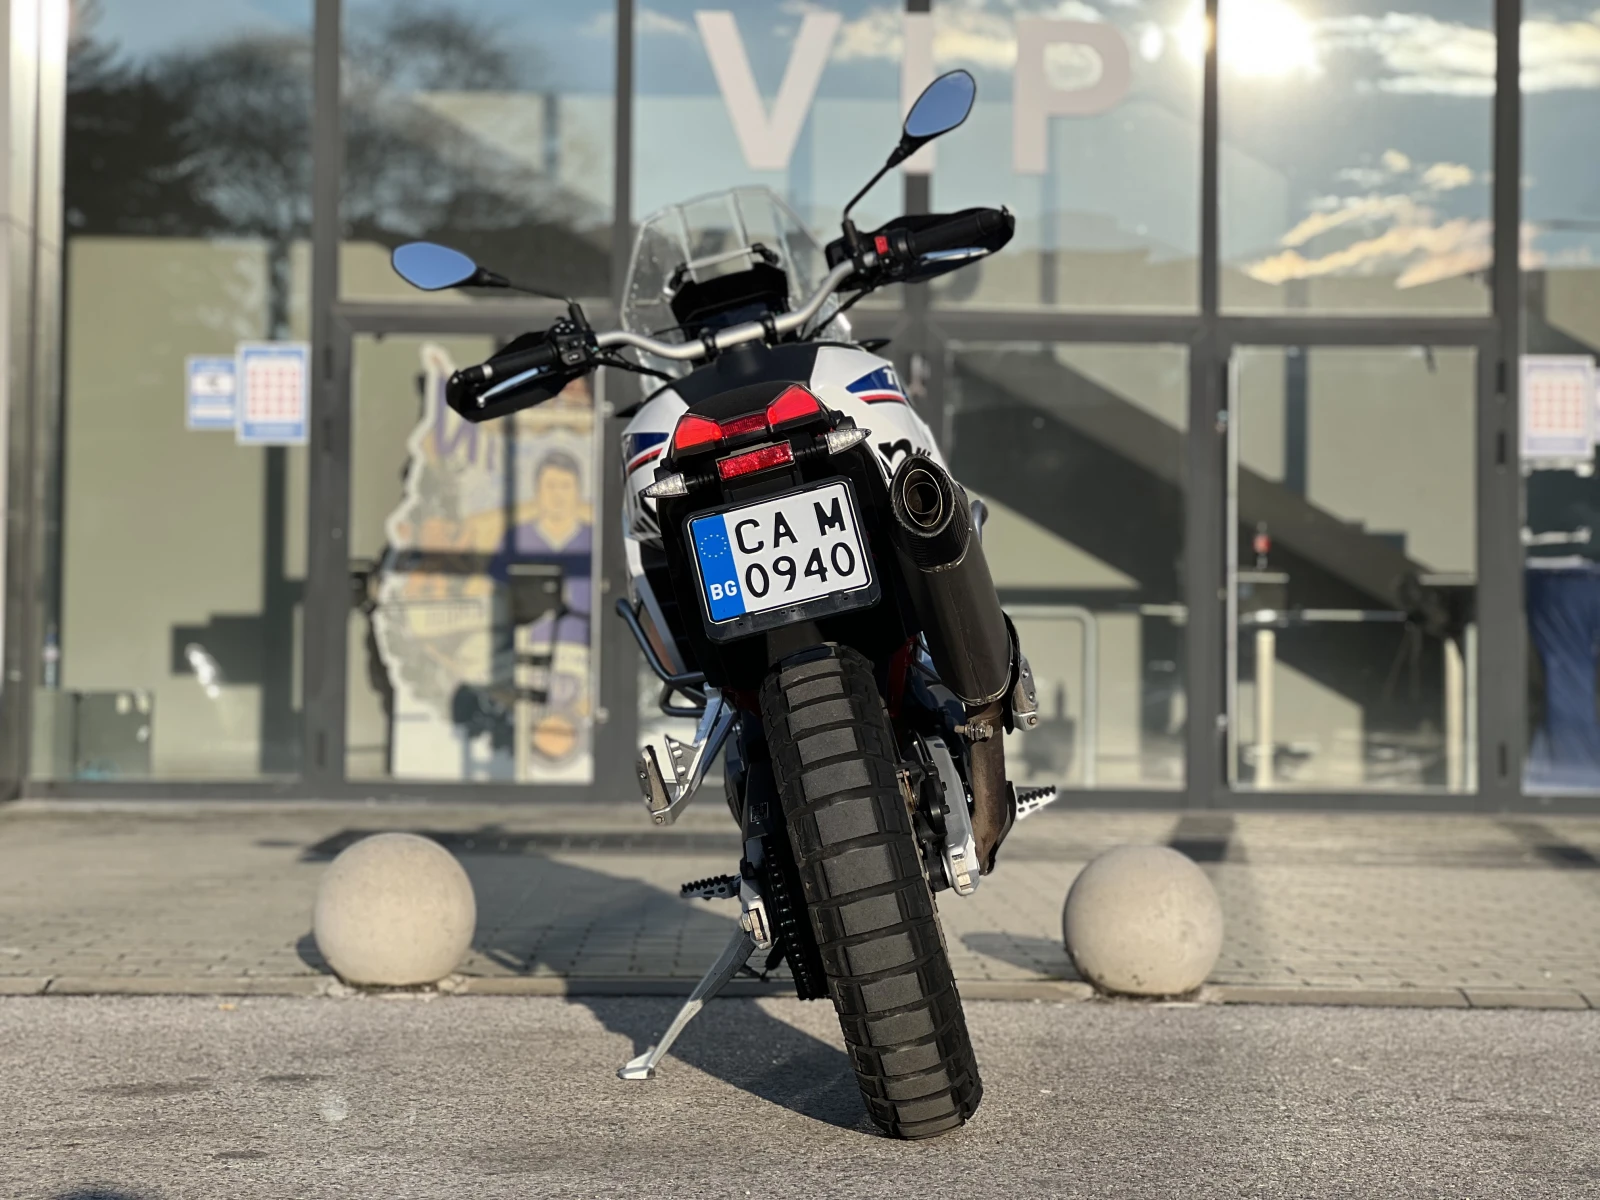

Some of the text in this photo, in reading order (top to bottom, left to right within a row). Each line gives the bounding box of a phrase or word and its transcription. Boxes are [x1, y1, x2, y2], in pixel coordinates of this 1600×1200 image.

[694, 11, 1131, 174] VIP
[734, 497, 847, 554] CA M
[710, 580, 738, 601] BG
[745, 542, 856, 598] 0940
